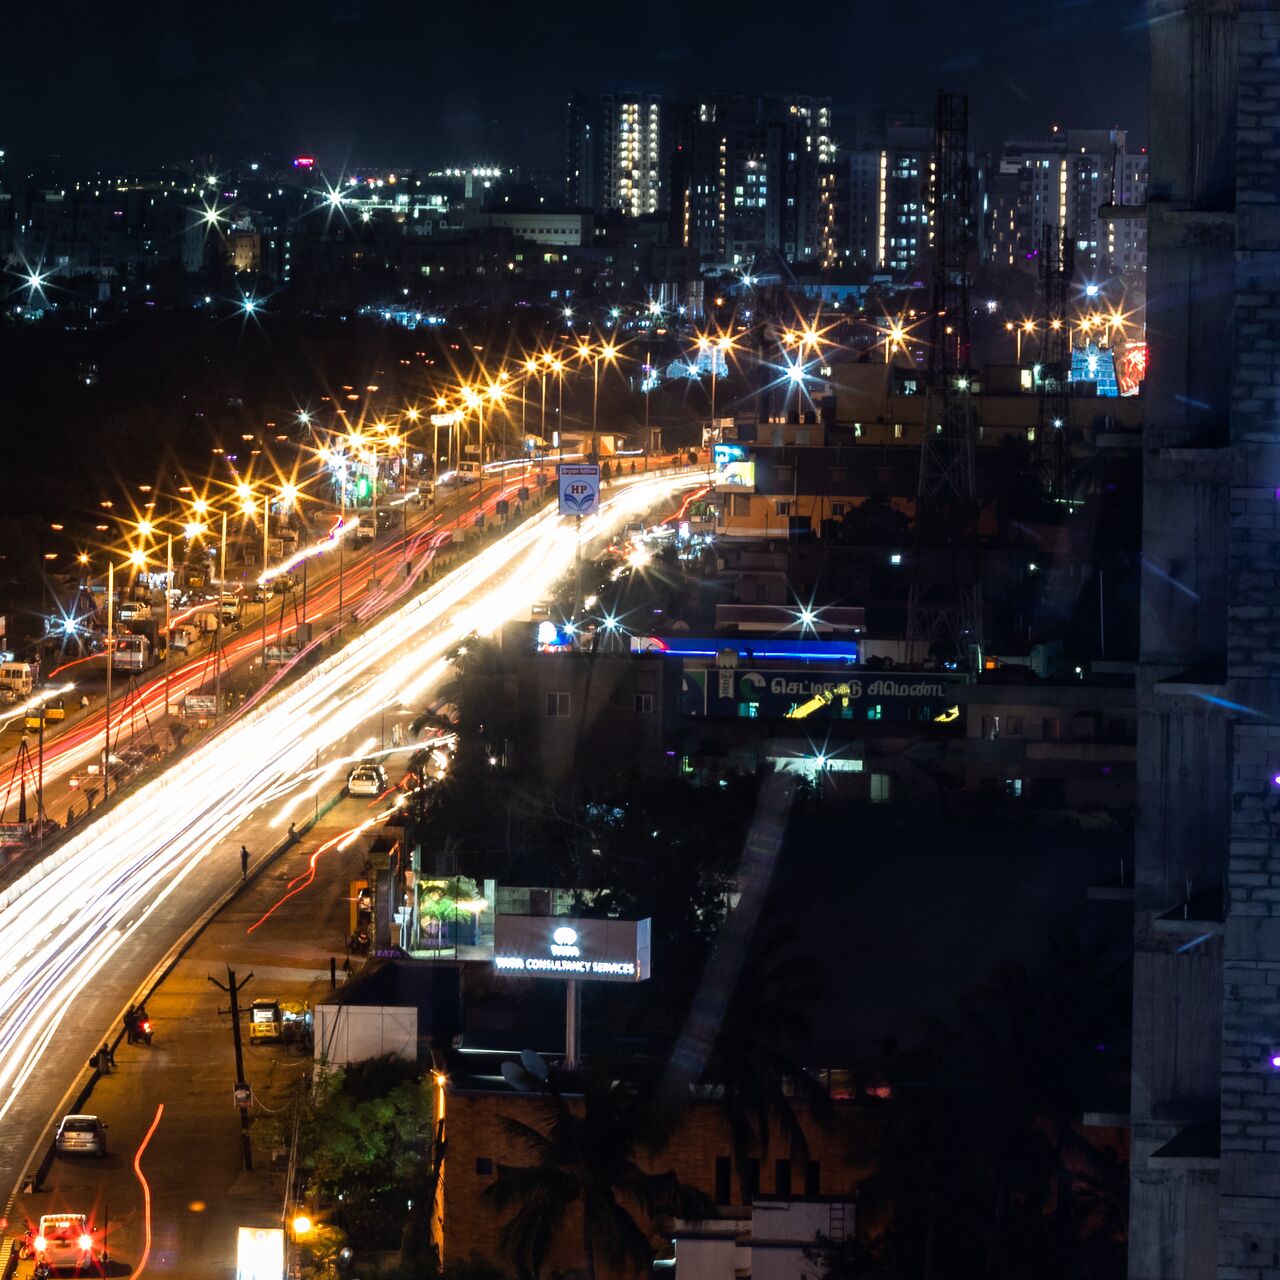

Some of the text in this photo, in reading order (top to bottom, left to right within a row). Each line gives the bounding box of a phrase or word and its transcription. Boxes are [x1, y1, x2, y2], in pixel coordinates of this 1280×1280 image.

[571, 484, 588, 494] HP
[526, 958, 592, 973] CONSULTANCY
[593, 962, 636, 975] SERVICES
